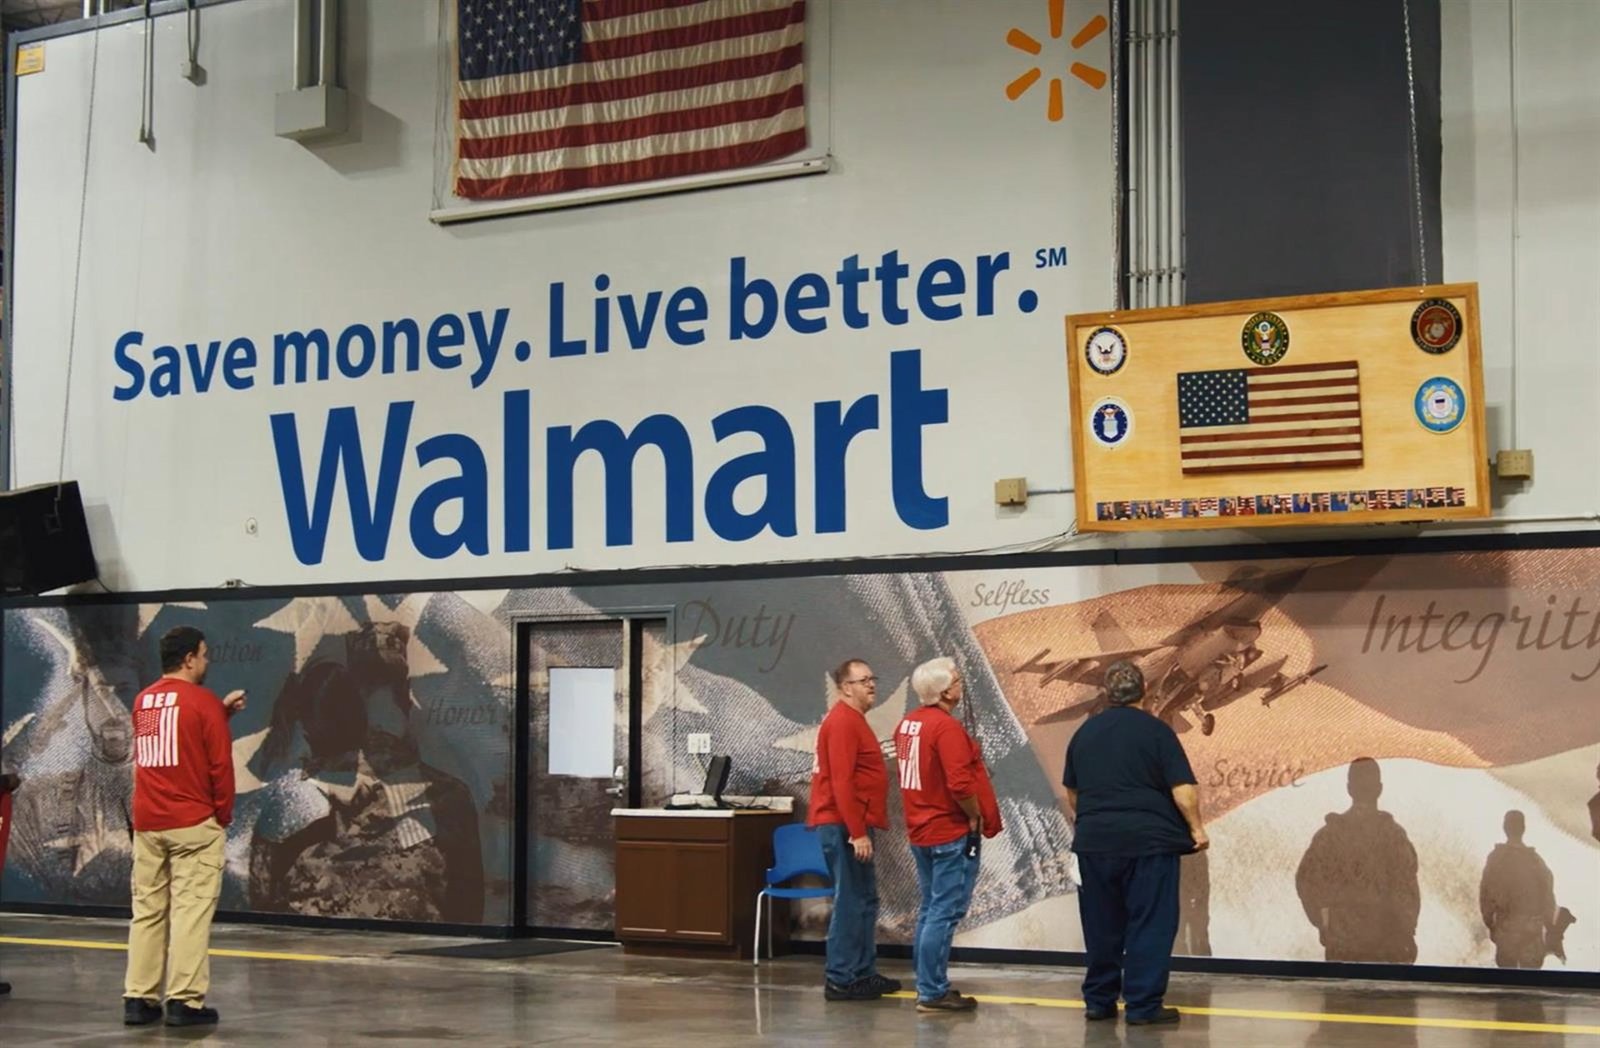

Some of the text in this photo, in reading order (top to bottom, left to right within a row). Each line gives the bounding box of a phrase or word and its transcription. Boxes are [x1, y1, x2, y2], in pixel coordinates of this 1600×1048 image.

[113, 246, 1067, 401] Save money. Live better. SM
[270, 349, 949, 566] Walmart
[970, 579, 1050, 615] Selfless
[682, 596, 796, 673] Duty
[426, 697, 499, 726] Honor
[1208, 758, 1307, 788] Service
